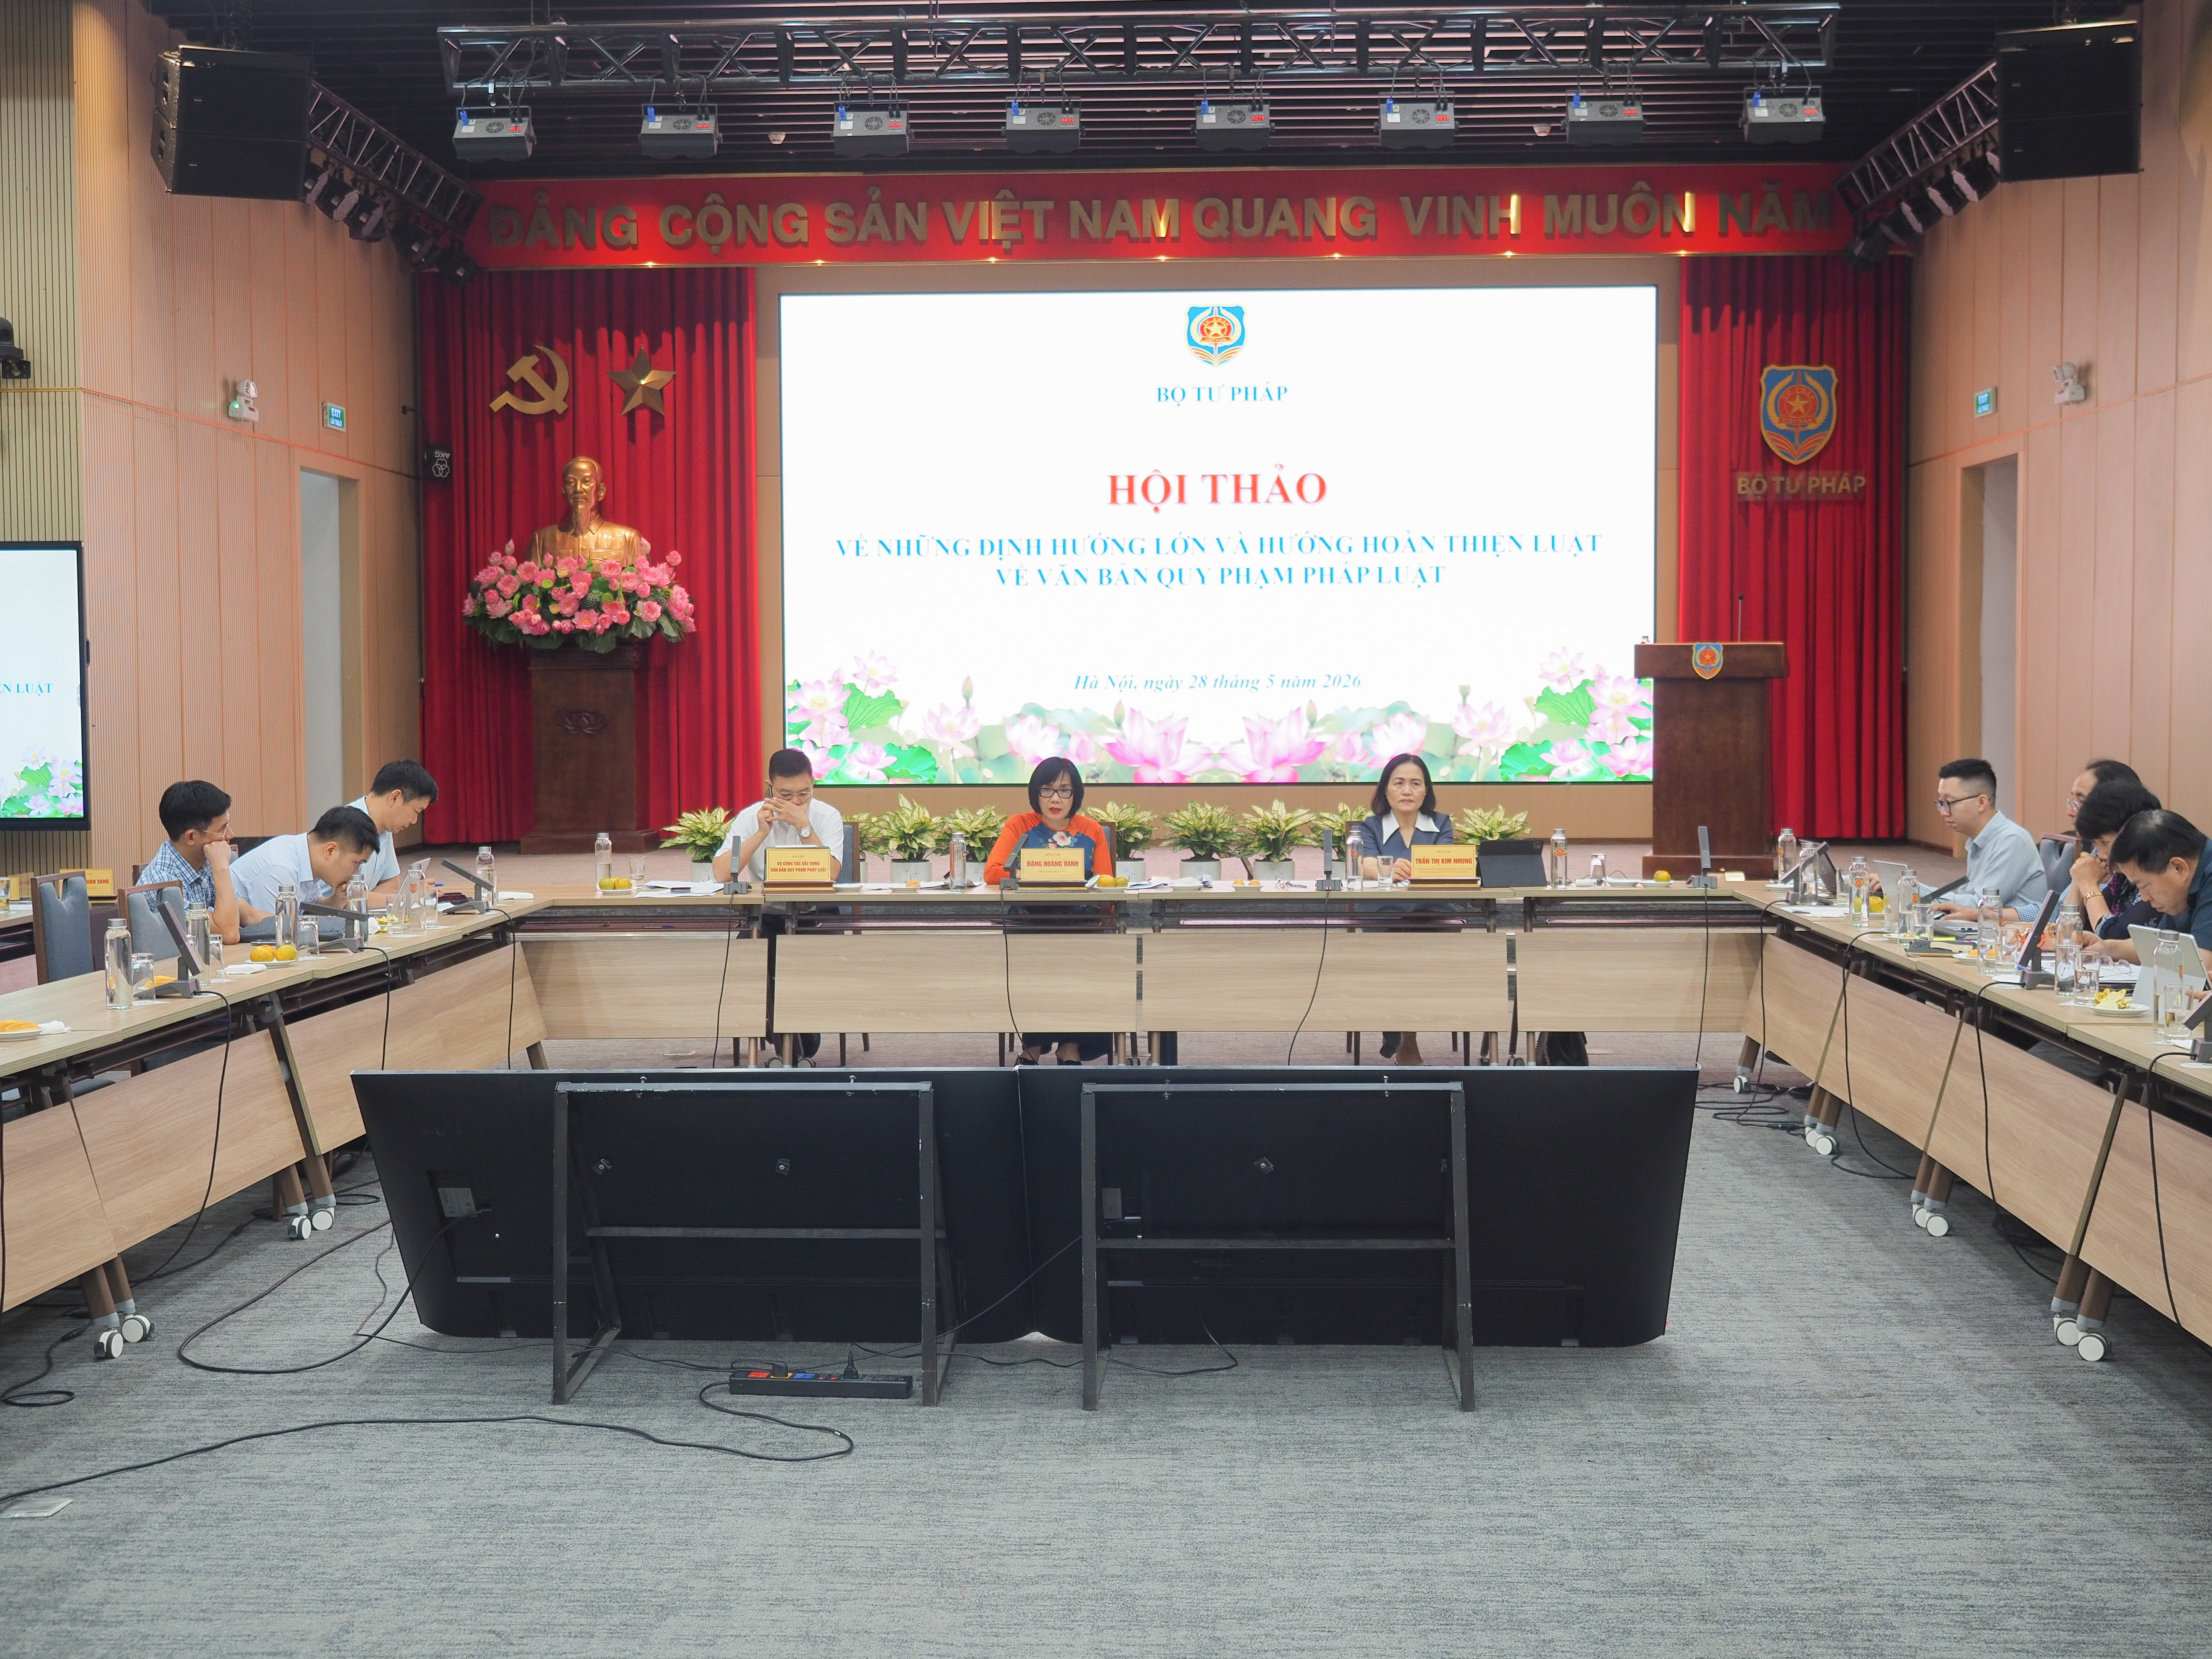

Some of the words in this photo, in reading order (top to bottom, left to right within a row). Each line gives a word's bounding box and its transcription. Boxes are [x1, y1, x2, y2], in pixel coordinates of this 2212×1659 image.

[489, 190, 638, 246] ĐẢNG
[659, 193, 808, 254] CỘNG
[825, 186, 927, 242] SẢN
[943, 189, 1054, 249] VIỆT
[1070, 199, 1179, 239] NAM
[1193, 195, 1377, 238] QUANG
[1400, 195, 1520, 235] VINH
[1544, 181, 1695, 234] MUÔN
[1719, 181, 1833, 233] NĂM
[1157, 384, 1186, 407] BỘ
[1193, 384, 1225, 402] TƯ
[1231, 381, 1288, 402] PHÁP
[331, 407, 341, 418] EXIT
[1106, 469, 1188, 514] HỘI
[1201, 464, 1328, 505] THẢO
[1737, 474, 1767, 499] BỘ
[1772, 475, 1803, 494] TƯ
[1807, 473, 1866, 494] PHÁP
[835, 534, 868, 557] VỀ
[877, 534, 969, 557] NHỮNG
[978, 538, 1042, 561] ĐỊNH
[1051, 533, 1145, 556] HƯỚNG
[1155, 532, 1206, 556] LỚN
[1215, 531, 1249, 555] VÀ
[1258, 531, 1354, 555] HƯỚNG
[1362, 530, 1435, 554] HOÀN
[1444, 533, 1524, 558] THIỆN
[1533, 532, 1602, 557] LUẬT
[995, 563, 1028, 586] VỀ
[1036, 564, 1089, 586] VĂN
[1098, 562, 1148, 586] BẢN
[1157, 568, 1211, 589] QUY
[1219, 567, 1294, 590] PHẠM
[1304, 561, 1371, 585] PHÁP
[1377, 563, 1446, 588] LUẬT
[16, 682, 53, 696] LUẬT
[1074, 675, 1098, 690] Hà
[1104, 675, 1137, 693] Nội,
[1144, 675, 1183, 693] ngày
[1189, 675, 1208, 689] 28
[1213, 674, 1260, 693] tháng
[1266, 674, 1275, 689] 5
[1281, 675, 1316, 689] năm
[1322, 674, 1362, 688] 2026
